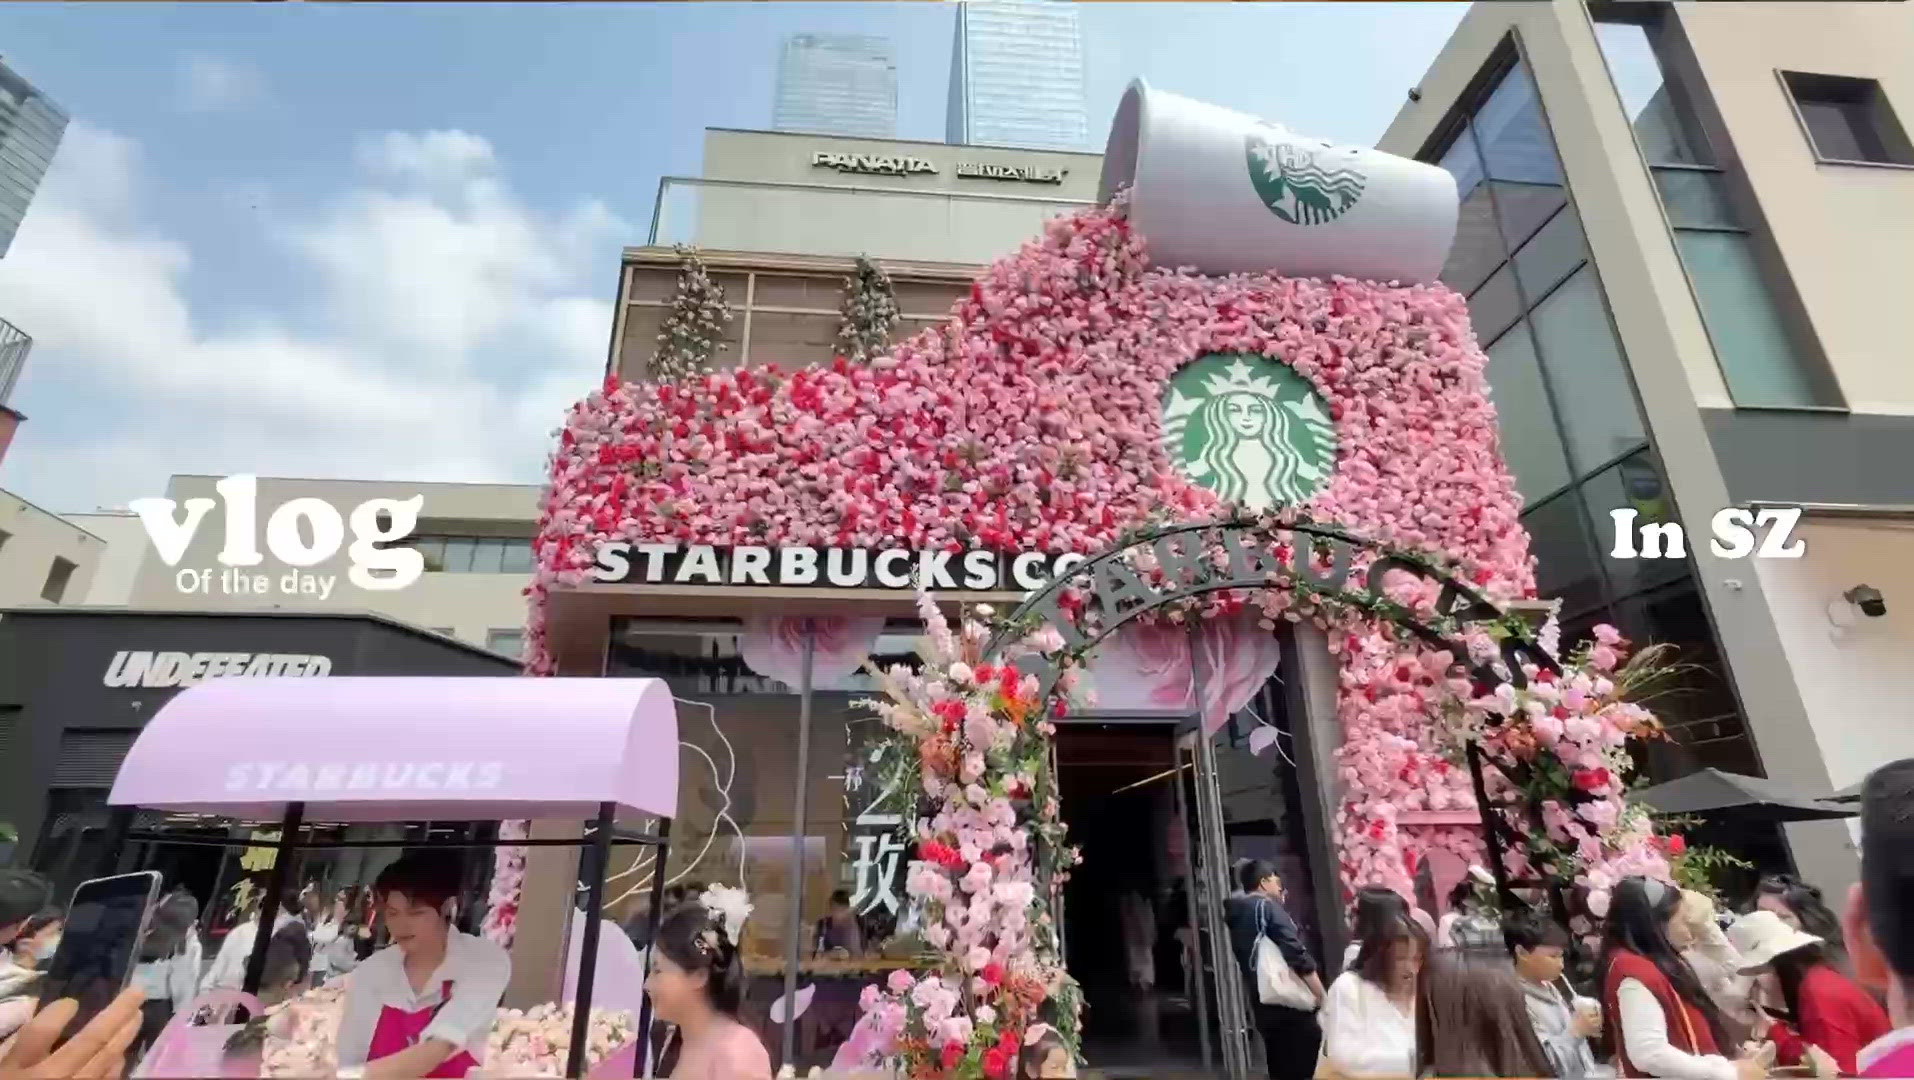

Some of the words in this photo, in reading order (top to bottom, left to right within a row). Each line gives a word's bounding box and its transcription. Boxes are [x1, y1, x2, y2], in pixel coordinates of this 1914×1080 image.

[594, 543, 998, 589] STARBUCKS
[103, 651, 332, 687] UNDEFEATED
[224, 761, 504, 792] STARBUCKS
